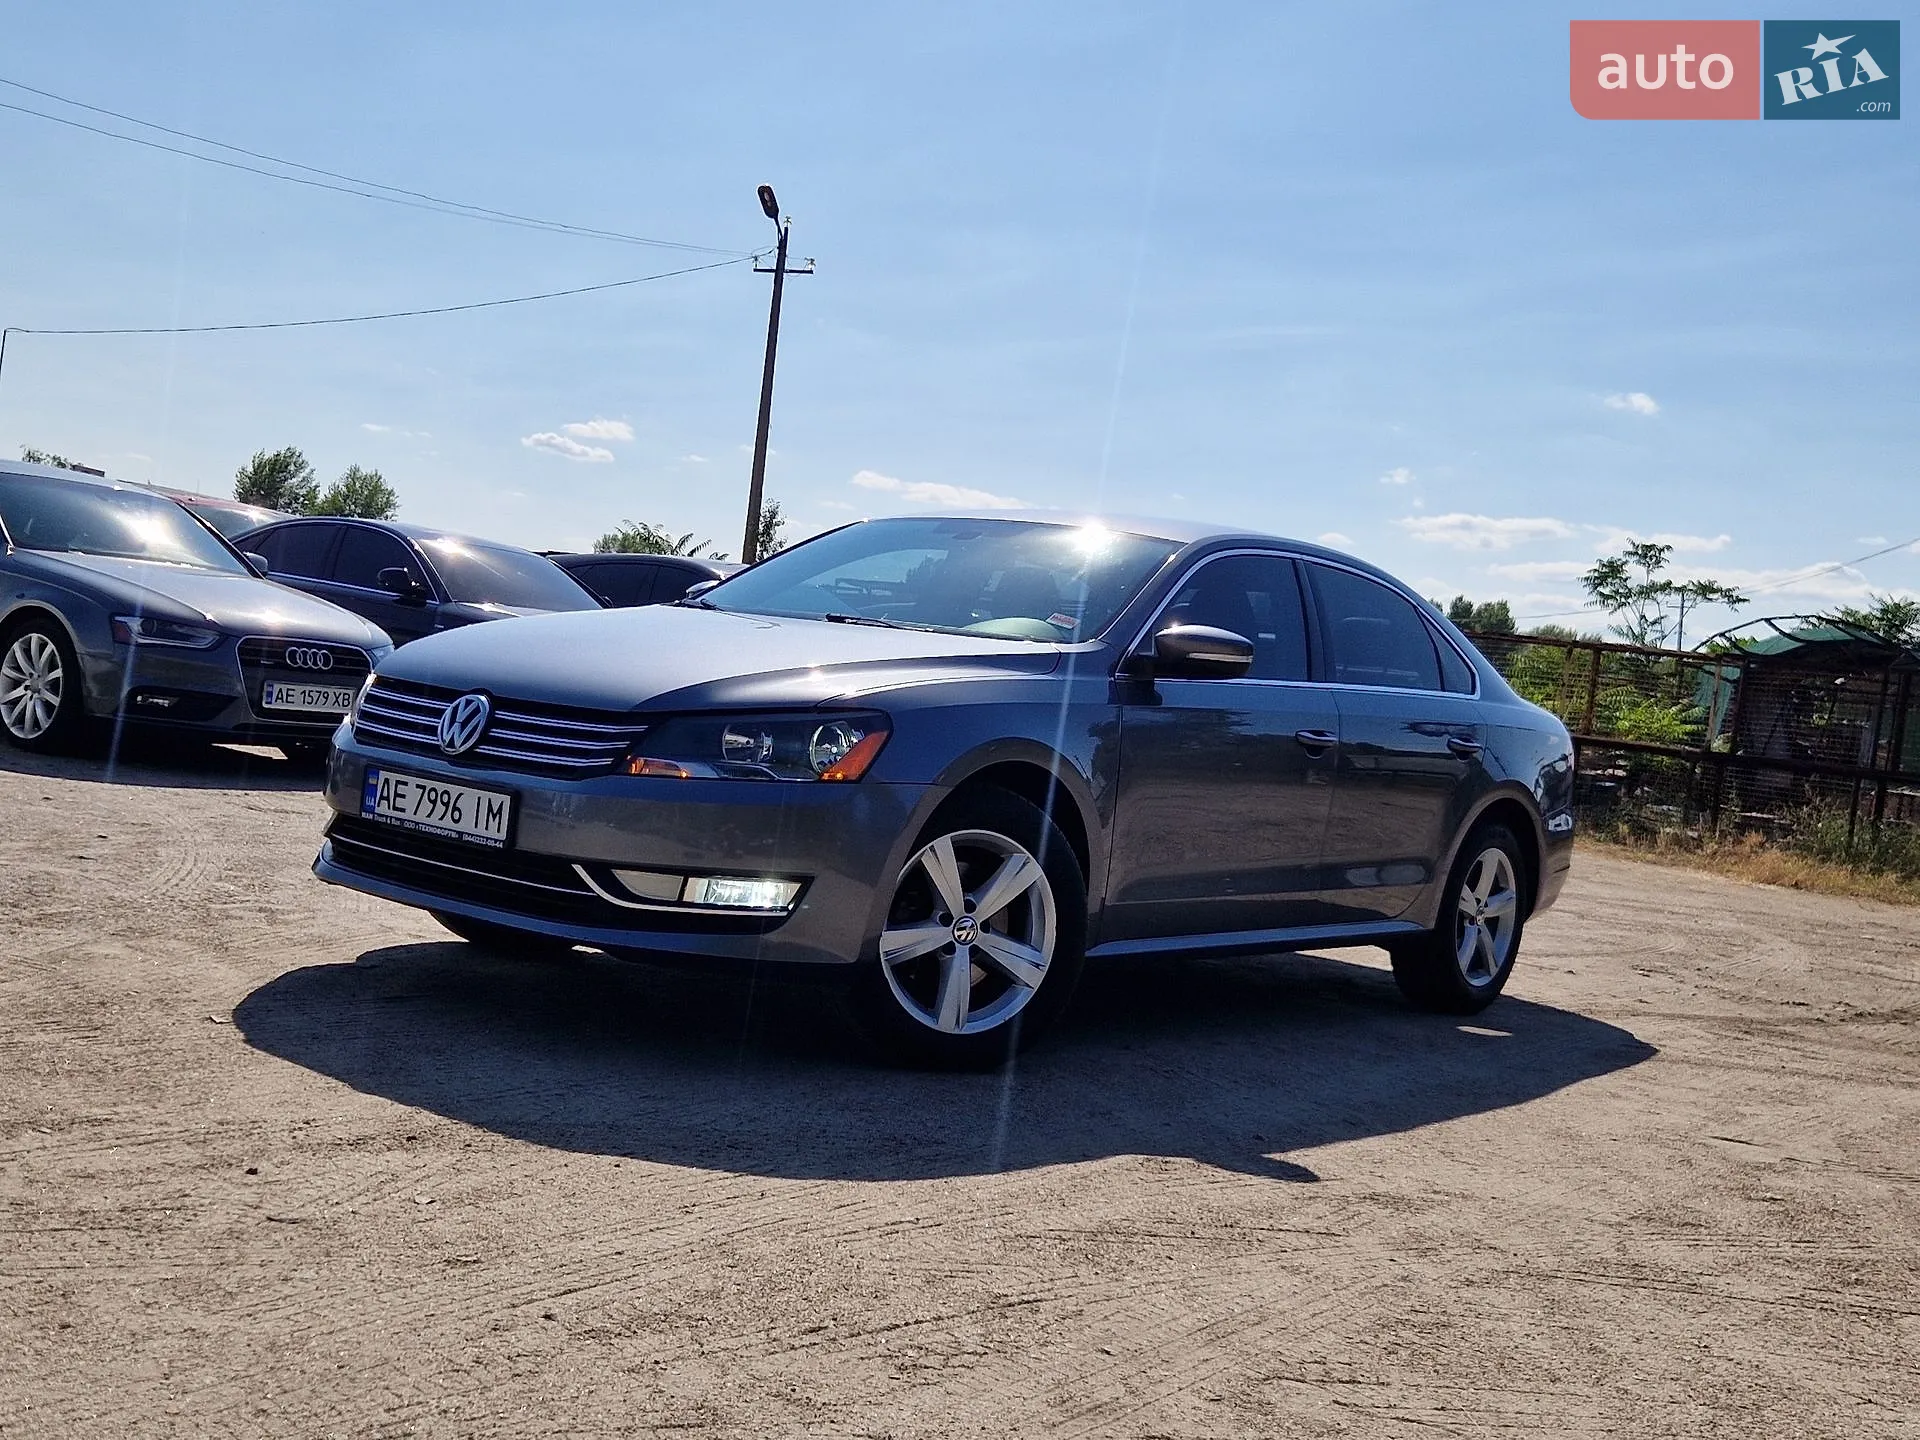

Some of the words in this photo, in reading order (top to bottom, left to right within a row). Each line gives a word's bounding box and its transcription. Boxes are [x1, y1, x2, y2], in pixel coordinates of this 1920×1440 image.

[274, 687, 295, 704] AE
[300, 689, 330, 706] 1579
[332, 692, 351, 708] XB
[365, 796, 376, 807] UA
[376, 777, 409, 813] AE
[413, 783, 464, 825] 7996
[474, 795, 504, 834] IM
